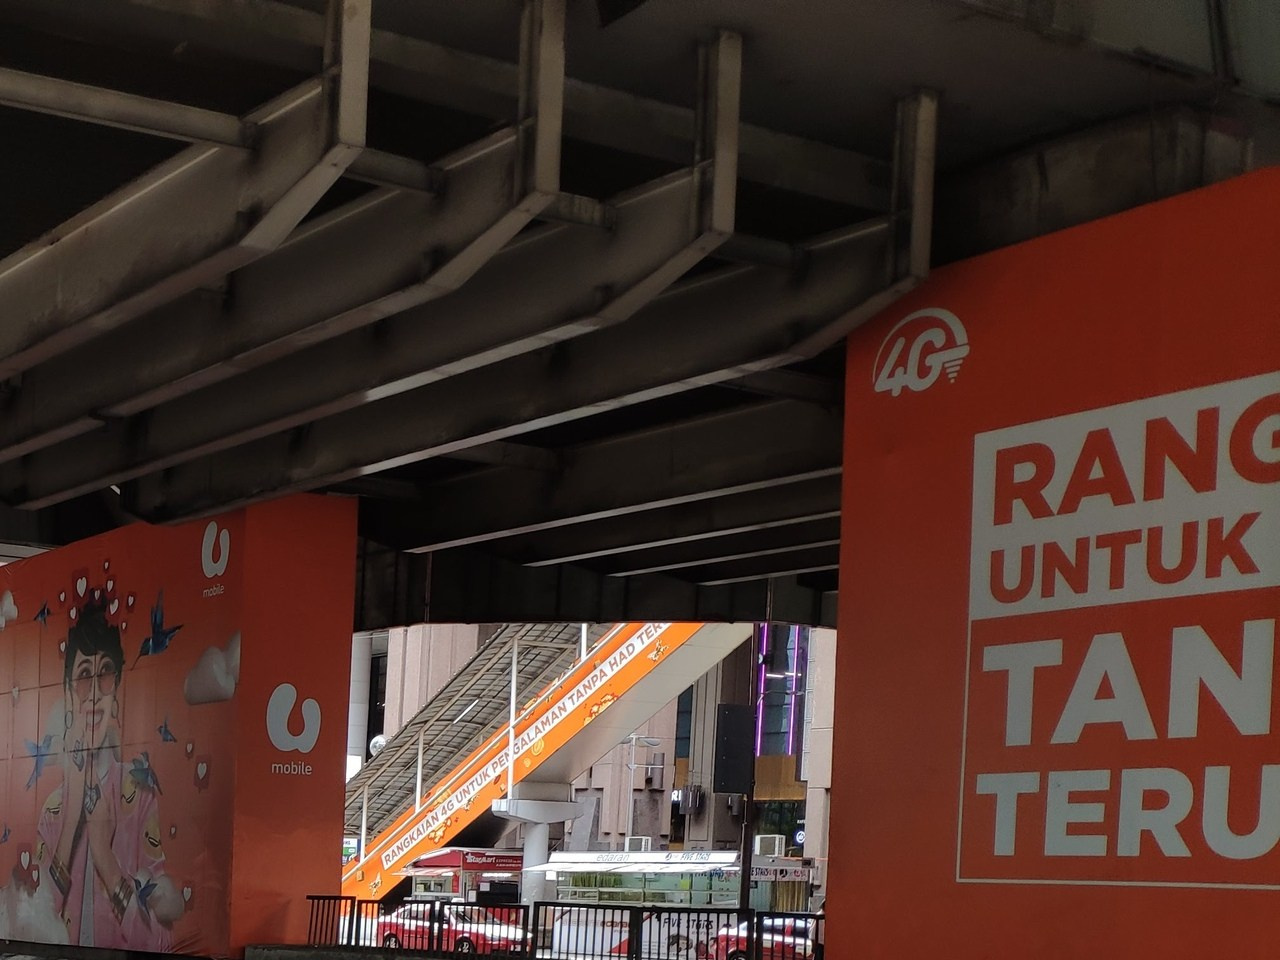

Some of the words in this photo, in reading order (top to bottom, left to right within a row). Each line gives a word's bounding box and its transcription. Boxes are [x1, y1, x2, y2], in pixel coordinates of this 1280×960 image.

[203, 584, 225, 598] mobile
[989, 511, 1260, 605] UNTUK
[982, 618, 1276, 748] TAN
[271, 761, 313, 775] mobile
[384, 808, 439, 864] RANGKAIAN
[440, 800, 456, 820] 4G
[455, 768, 491, 805] UNTUK
[491, 704, 568, 775] PENGALAMAN
[567, 669, 608, 706] TANPA
[609, 643, 636, 672] HAD
